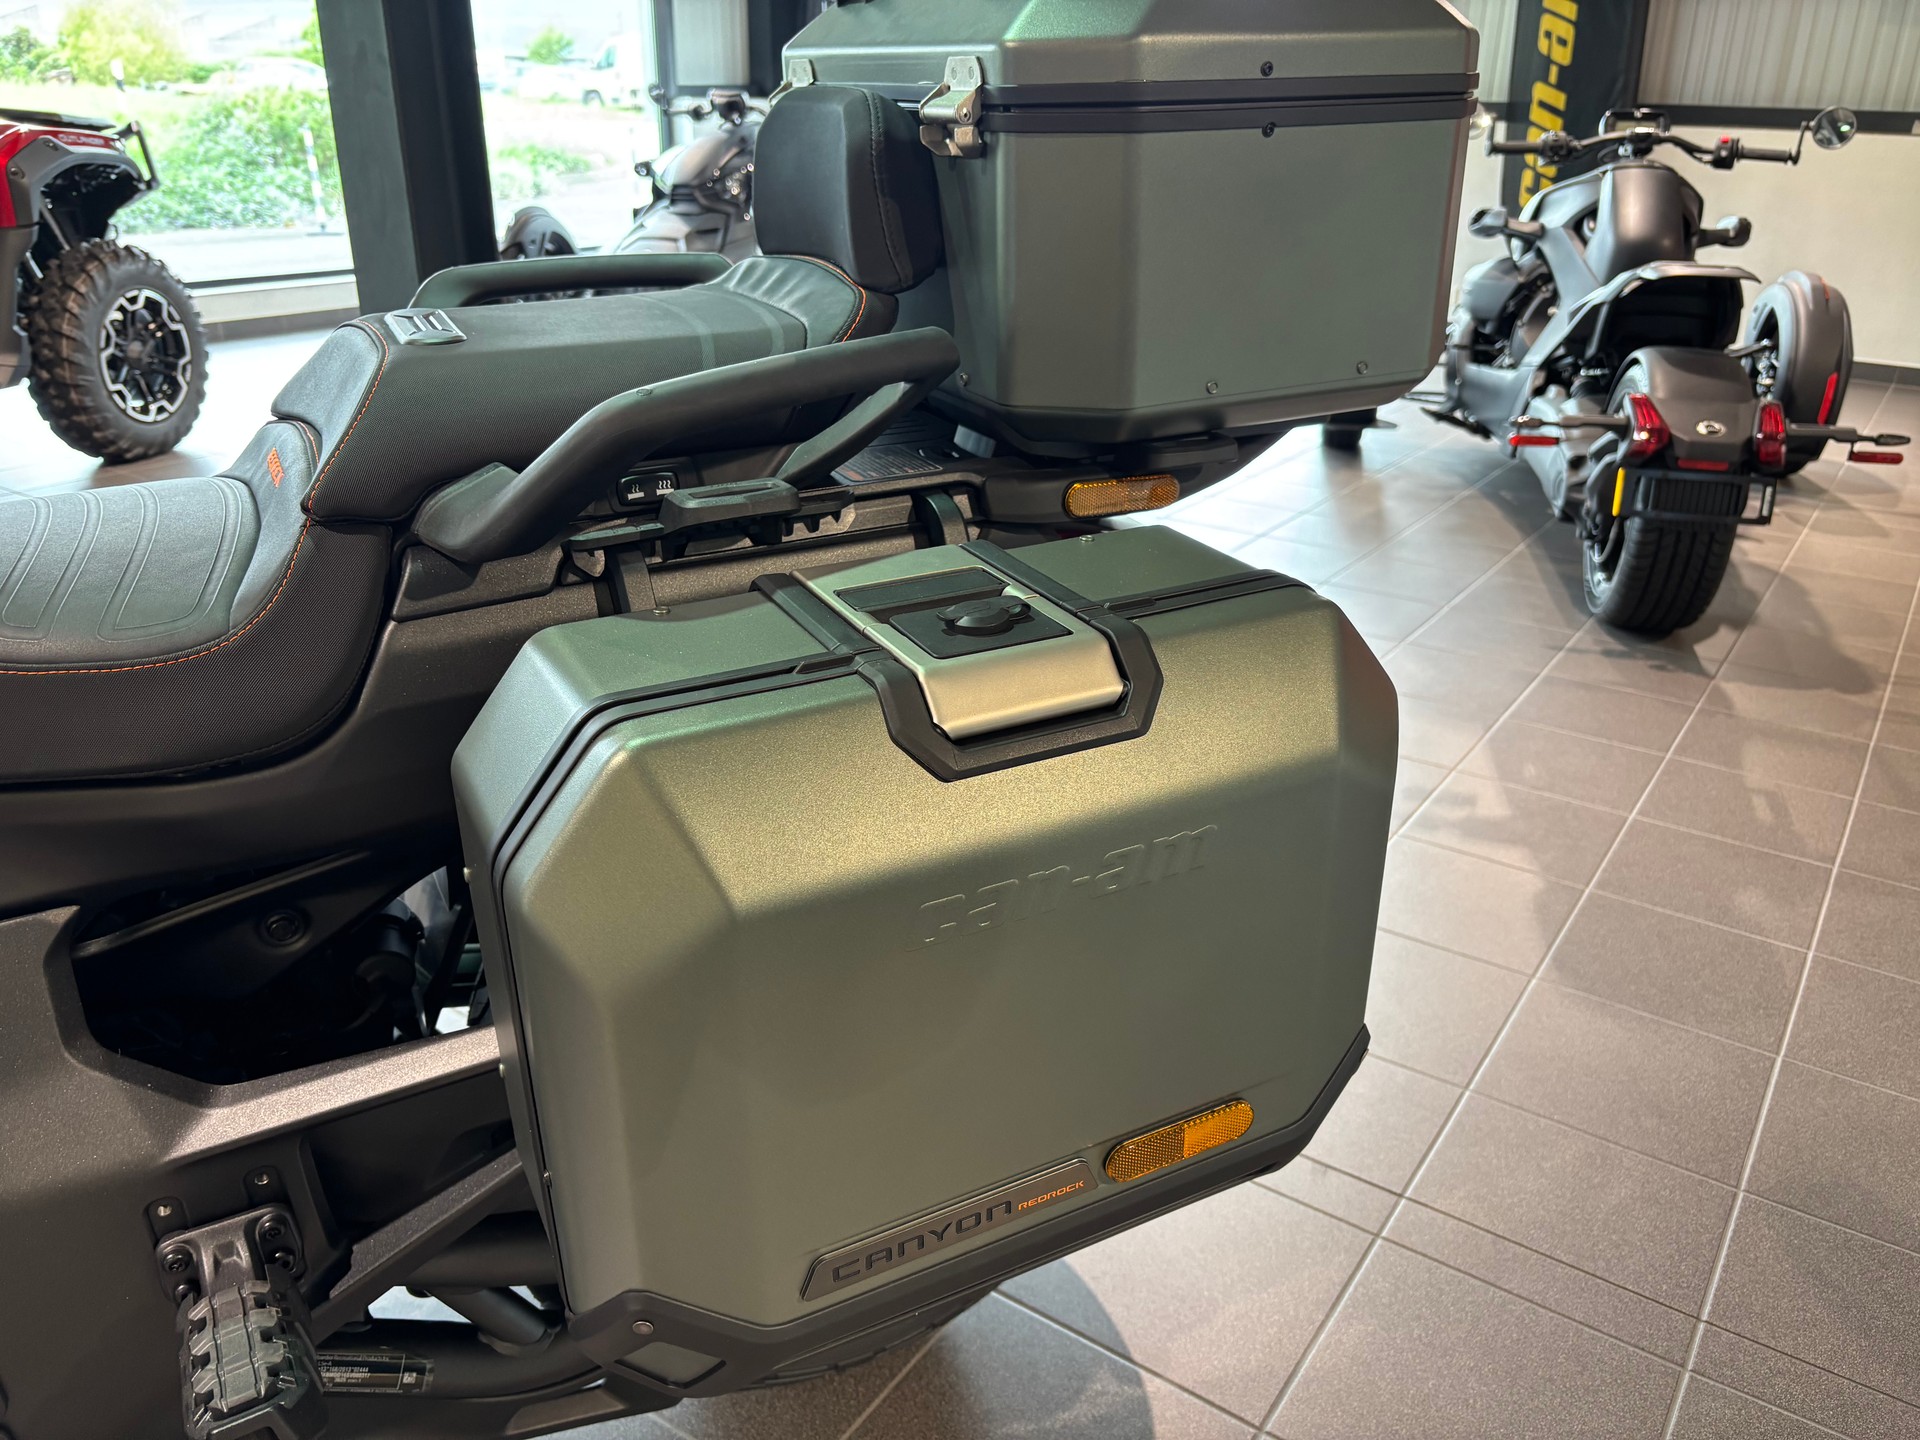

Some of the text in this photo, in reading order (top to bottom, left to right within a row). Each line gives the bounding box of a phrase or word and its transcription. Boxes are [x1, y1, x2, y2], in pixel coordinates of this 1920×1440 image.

[904, 824, 1217, 953] can-am
[832, 1180, 1085, 1283] CANYON REDROCK
